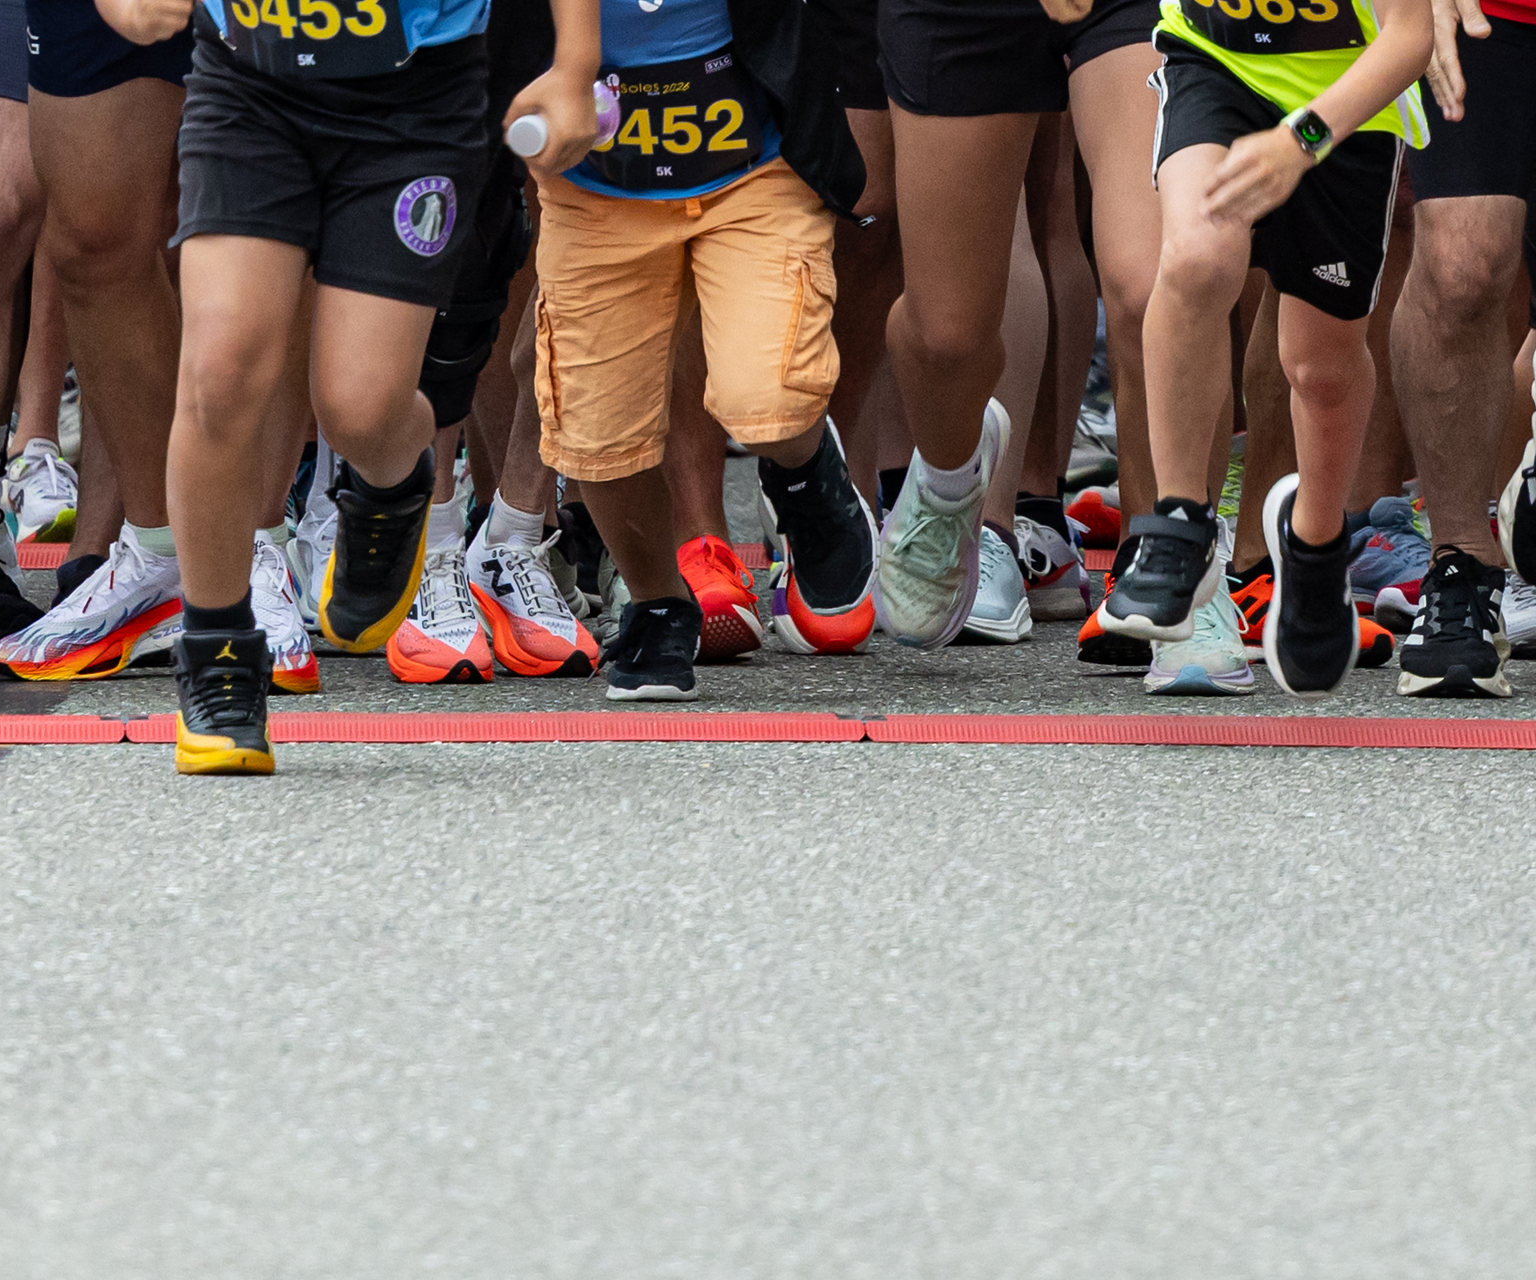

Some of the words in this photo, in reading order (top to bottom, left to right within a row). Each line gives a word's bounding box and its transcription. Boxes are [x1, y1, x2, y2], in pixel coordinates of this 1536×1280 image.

[1253, 32, 1272, 45] 5K
[297, 53, 316, 66] 5K
[619, 82, 661, 95] Soles
[594, 98, 748, 155] 452
[655, 166, 673, 178] 5K
[1312, 266, 1351, 288] adidas
